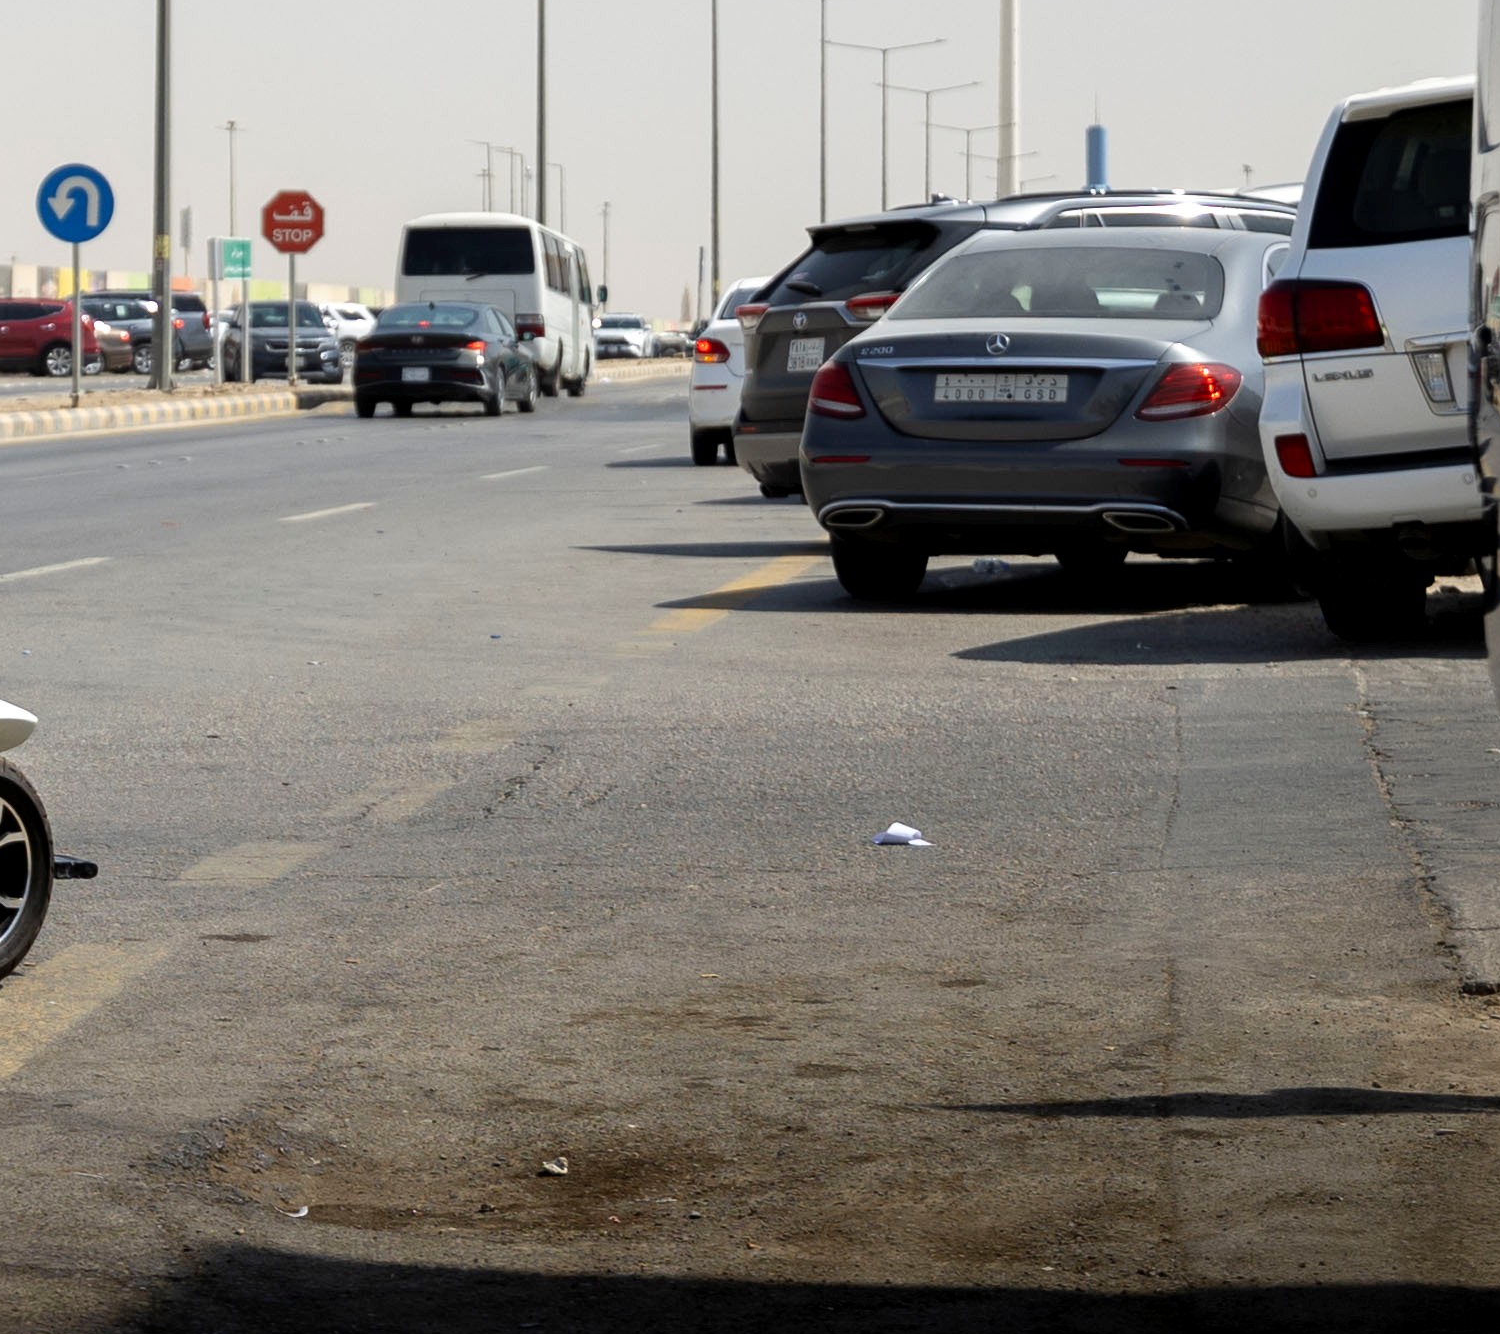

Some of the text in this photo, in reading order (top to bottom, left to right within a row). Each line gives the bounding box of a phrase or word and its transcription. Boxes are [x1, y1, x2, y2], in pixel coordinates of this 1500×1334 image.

[272, 201, 313, 221] قف
[272, 228, 313, 243] STOP
[1312, 369, 1374, 382] LEXUS
[1023, 389, 1057, 400] GSD
